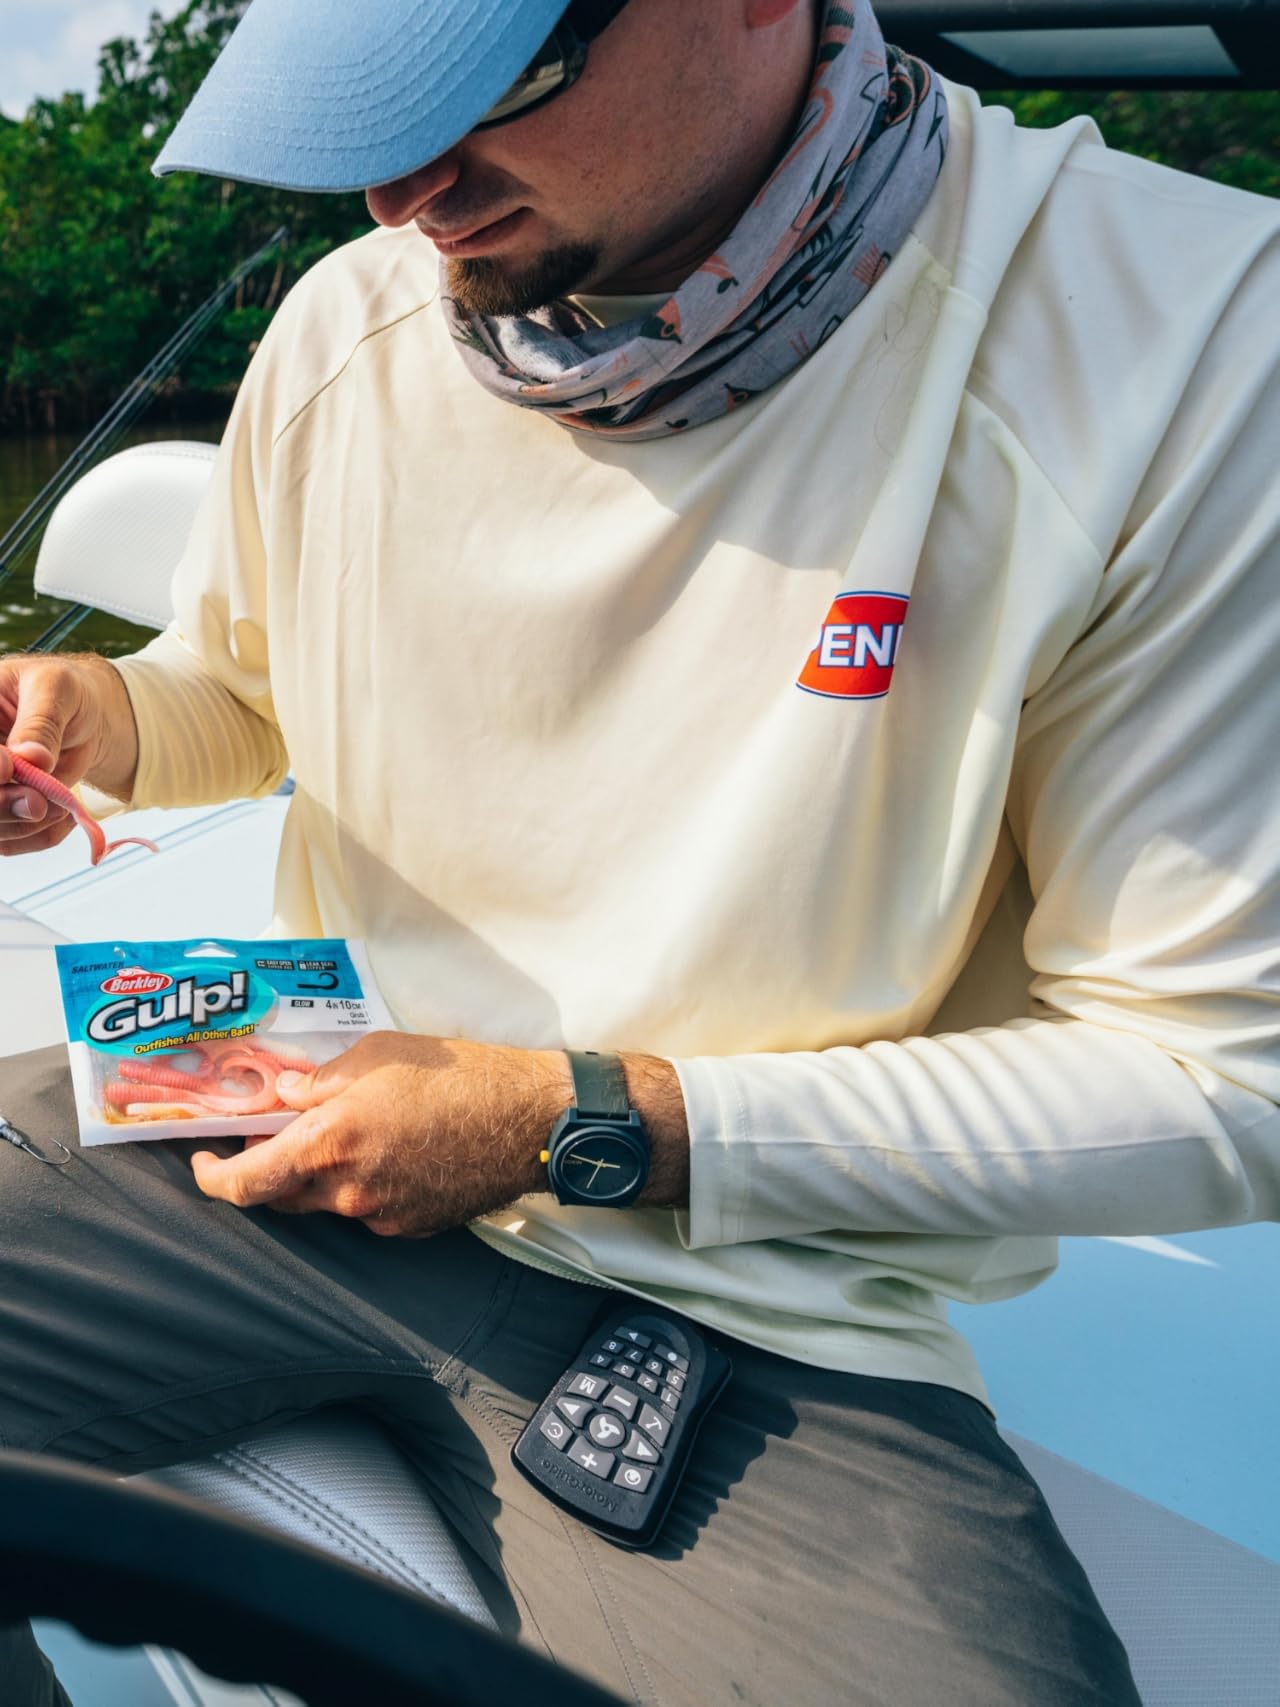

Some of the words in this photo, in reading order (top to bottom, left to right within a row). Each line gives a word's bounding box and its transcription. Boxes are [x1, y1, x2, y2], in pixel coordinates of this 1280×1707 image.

[71, 961, 125, 975] SALTWATER
[109, 975, 166, 992] Berkley
[87, 970, 249, 1043] Gulp!
[134, 1035, 184, 1055] Outfishes
[186, 1030, 200, 1043] All
[202, 1029, 229, 1042] Other
[230, 1024, 255, 1038] Bait!
[608, 1341, 617, 1350] 8
[597, 1354, 605, 1364] 4
[630, 1351, 638, 1360] 7
[620, 1364, 629, 1374] 3
[651, 1361, 659, 1370] 6
[643, 1377, 653, 1387] 2
[671, 1375, 680, 1385] 5
[578, 1376, 597, 1395] M
[666, 1393, 672, 1402] 1
